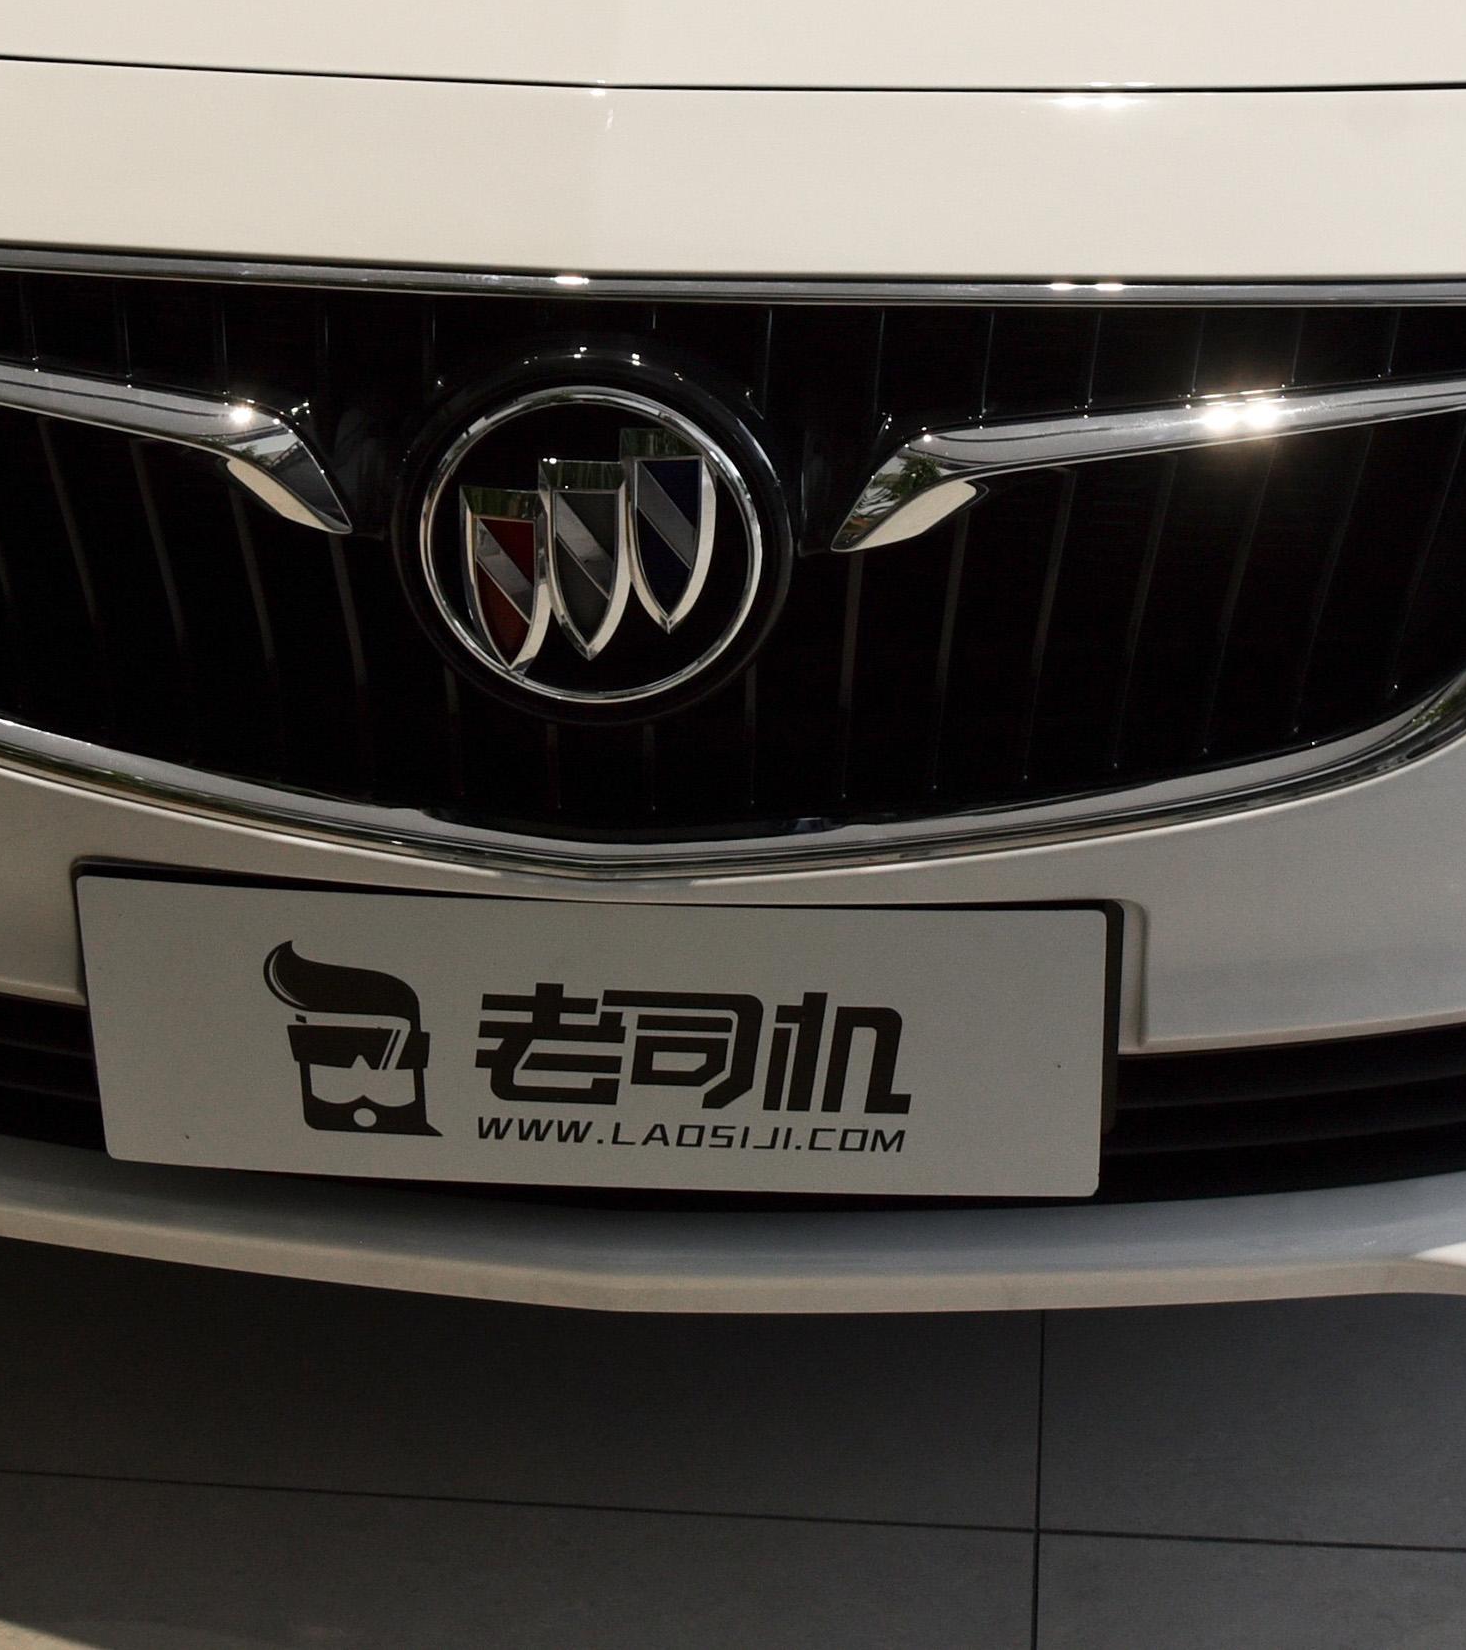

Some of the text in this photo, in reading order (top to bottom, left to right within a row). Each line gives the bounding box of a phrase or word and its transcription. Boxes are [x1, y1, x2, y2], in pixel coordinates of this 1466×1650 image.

[475, 982, 912, 1114] 老司机
[477, 1116, 907, 1153] WWW.LAOSIJI.COM
